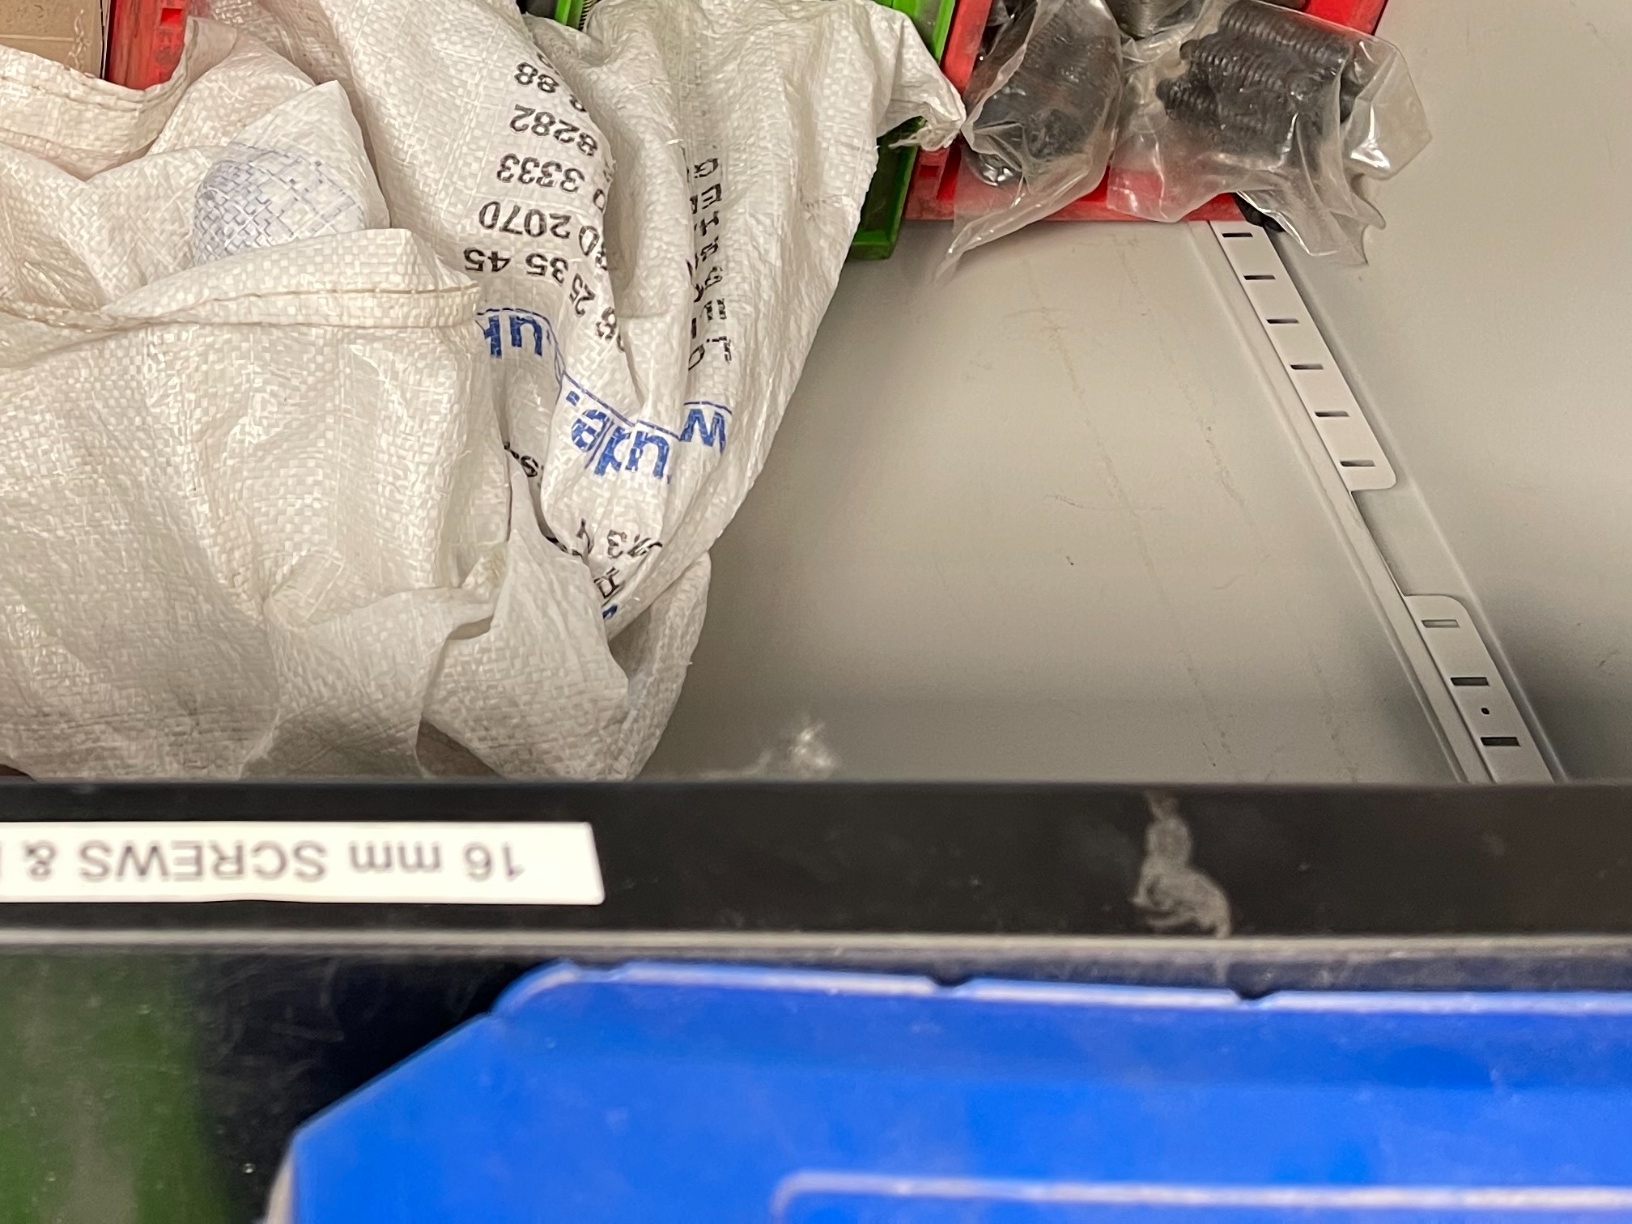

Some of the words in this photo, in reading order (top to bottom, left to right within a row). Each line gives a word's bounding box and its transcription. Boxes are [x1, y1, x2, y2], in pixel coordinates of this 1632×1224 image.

[509, 104, 598, 157] 8282
[496, 153, 585, 193] 3333
[478, 201, 572, 240] 2070
[463, 247, 512, 273] 45
[23, 839, 58, 882] &
[78, 839, 328, 883] SCREWS
[349, 840, 443, 873] mm
[464, 841, 525, 882] 16
